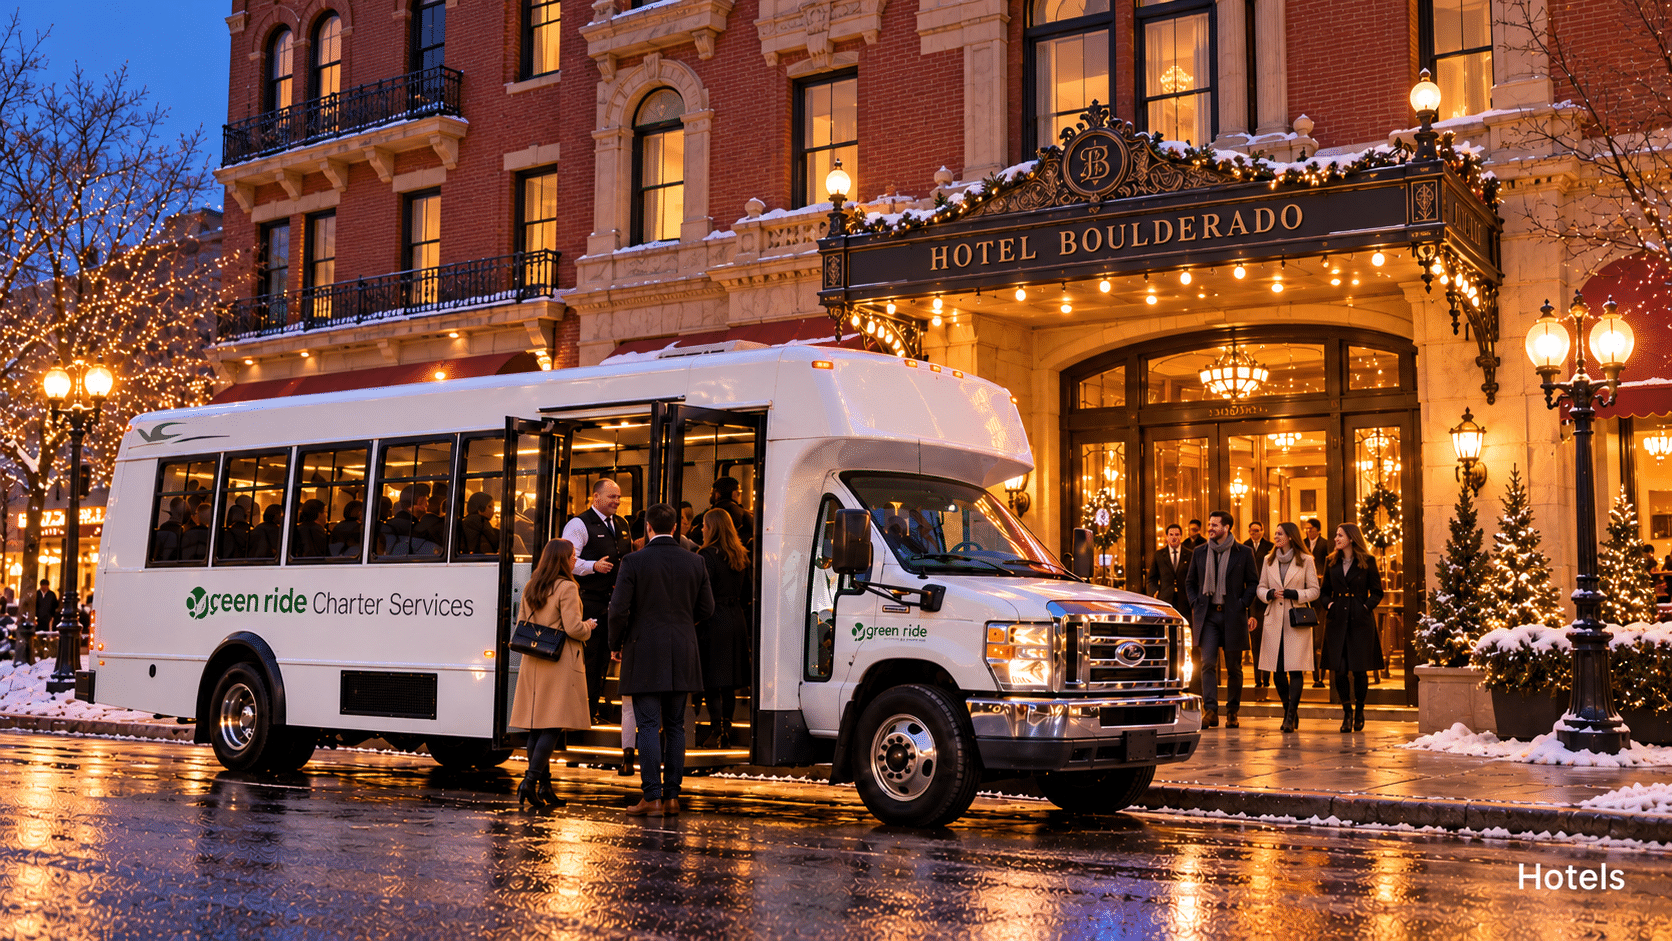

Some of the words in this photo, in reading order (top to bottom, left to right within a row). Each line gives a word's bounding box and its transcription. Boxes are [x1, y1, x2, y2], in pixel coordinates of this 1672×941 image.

[930, 236, 1037, 271] HOTEL
[1059, 203, 1304, 256] BOULDERADO
[264, 586, 307, 613] ride
[312, 591, 384, 614] Charter
[389, 592, 474, 617] Services
[866, 626, 899, 640] green
[903, 623, 928, 638] ride
